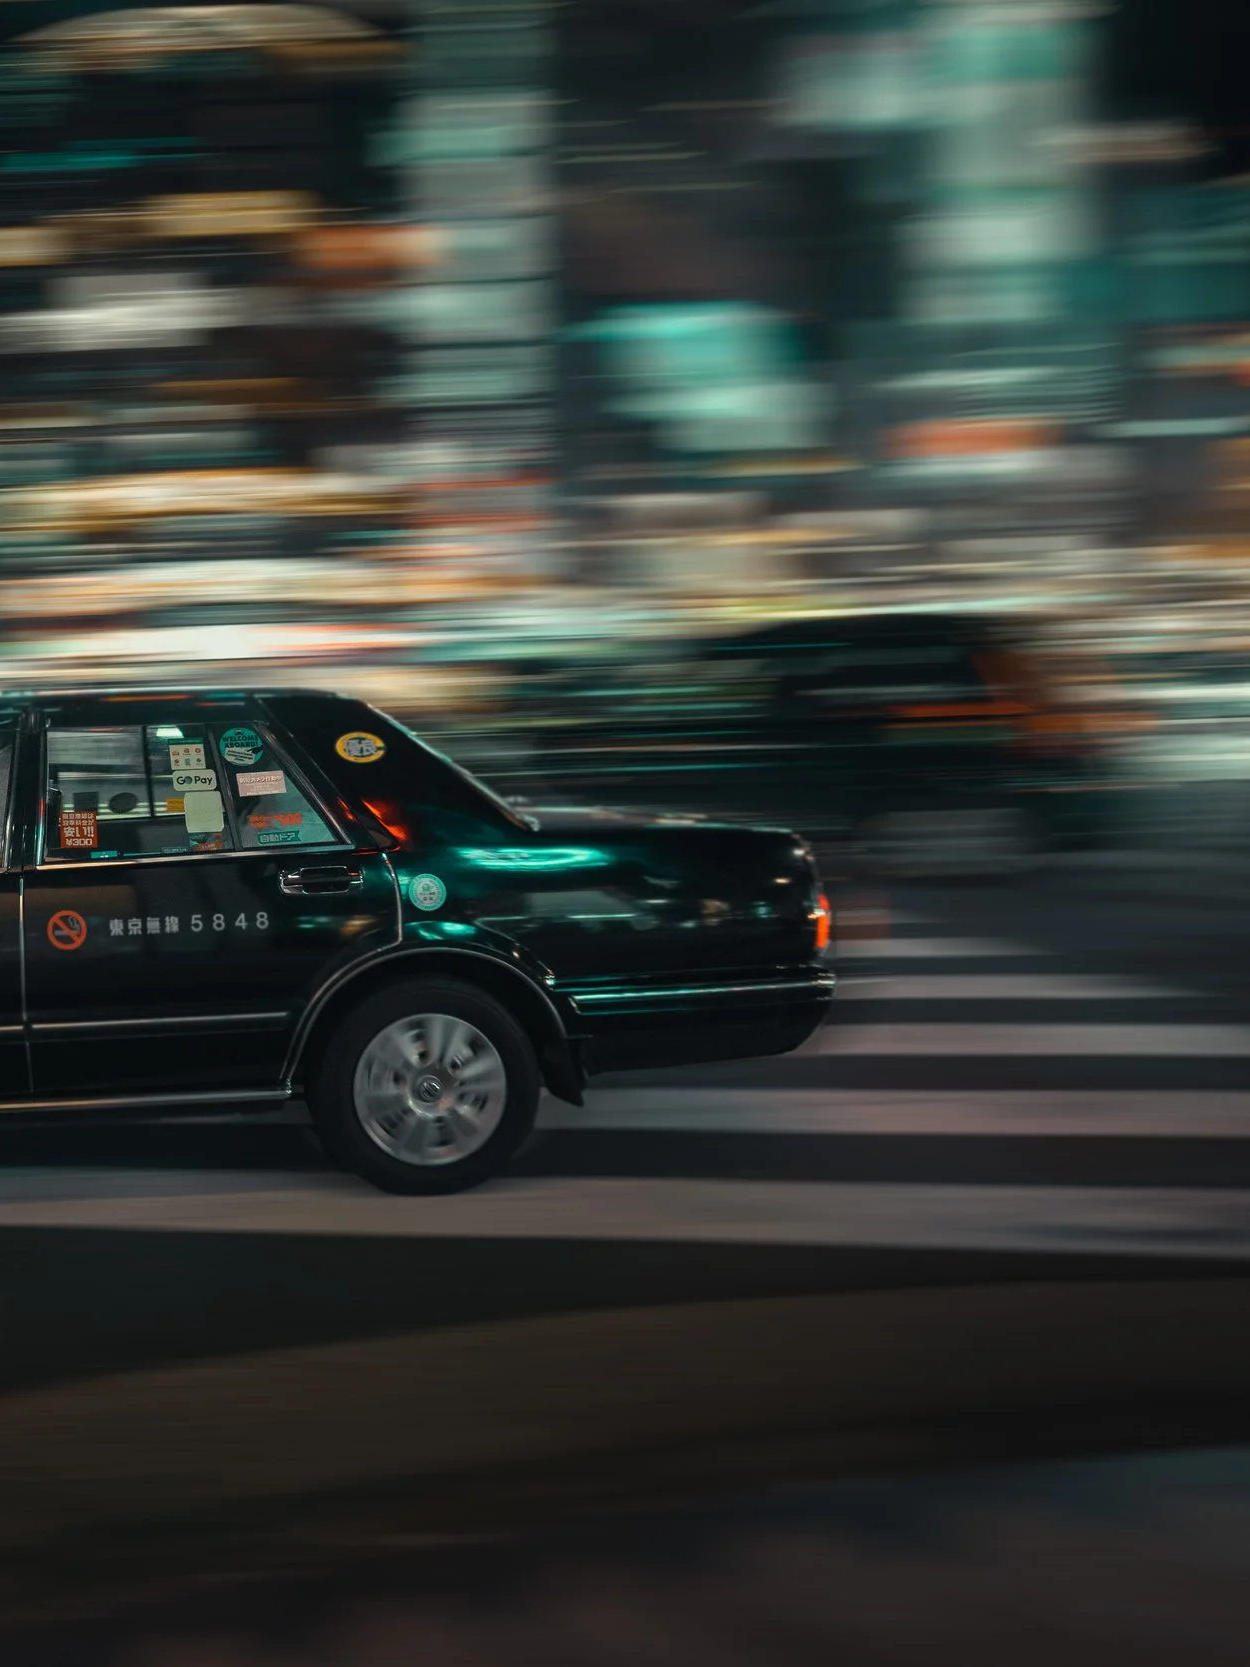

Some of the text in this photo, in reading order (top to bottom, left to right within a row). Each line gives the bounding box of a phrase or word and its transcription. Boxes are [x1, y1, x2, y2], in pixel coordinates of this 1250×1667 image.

[222, 734, 258, 742] WELCOME
[176, 775, 213, 786] GO Pay
[109, 911, 269, 936] 東京無線 5848
